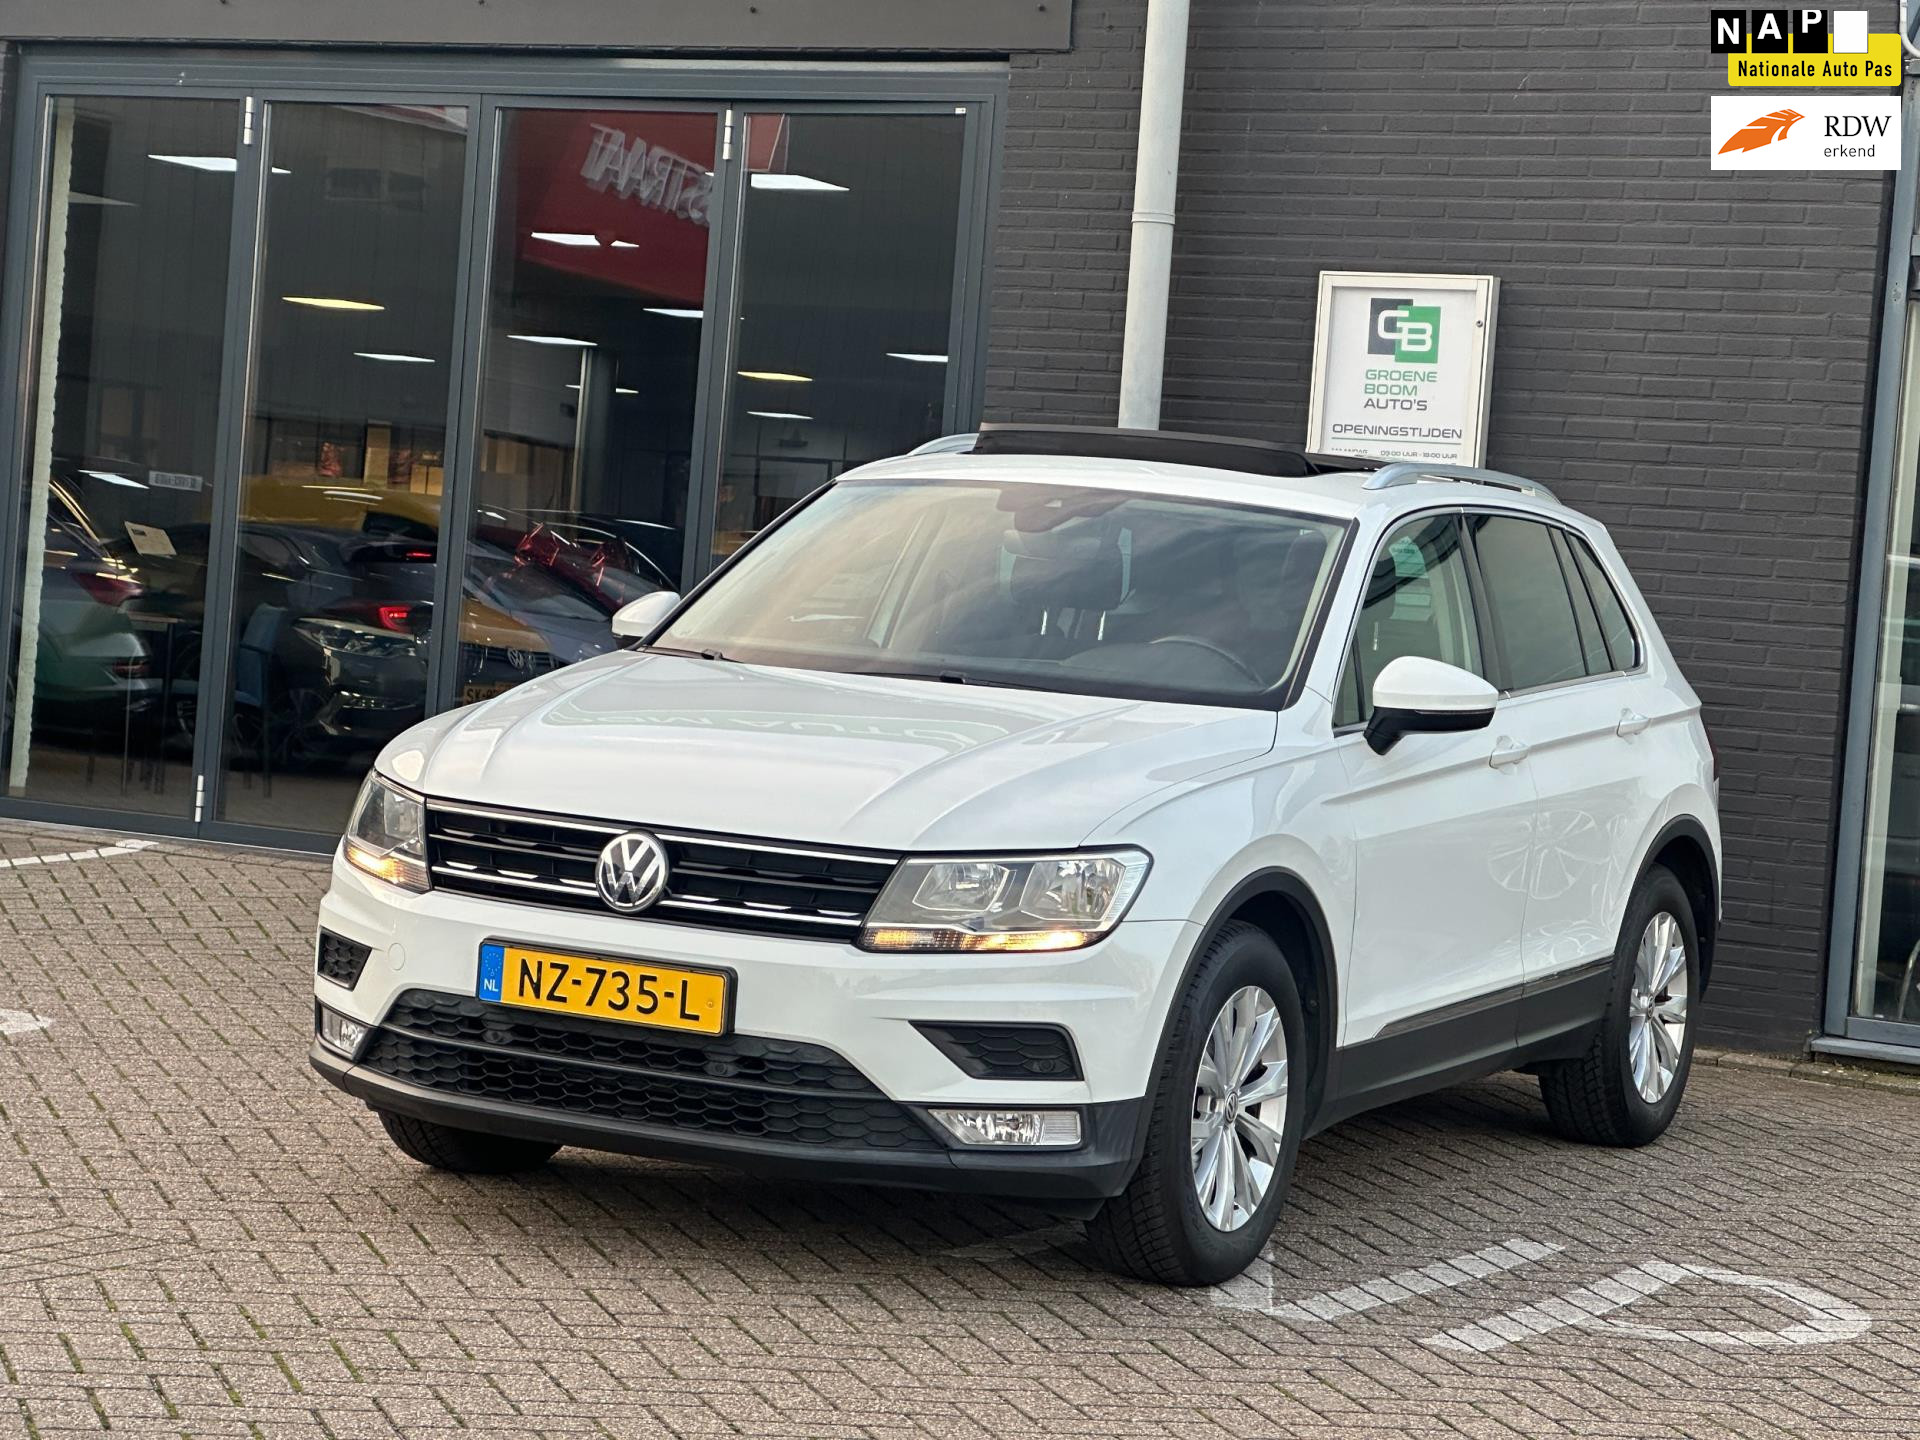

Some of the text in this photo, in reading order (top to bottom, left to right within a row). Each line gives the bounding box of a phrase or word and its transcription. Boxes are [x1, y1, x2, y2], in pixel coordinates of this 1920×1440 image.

[1365, 368, 1438, 383] GROENE
[1364, 383, 1418, 396] BOOM
[1363, 398, 1428, 411] AUTO'S
[1332, 423, 1462, 439] OPENINGSTIJDEN
[484, 958, 701, 1022] NL NZ-735-L
